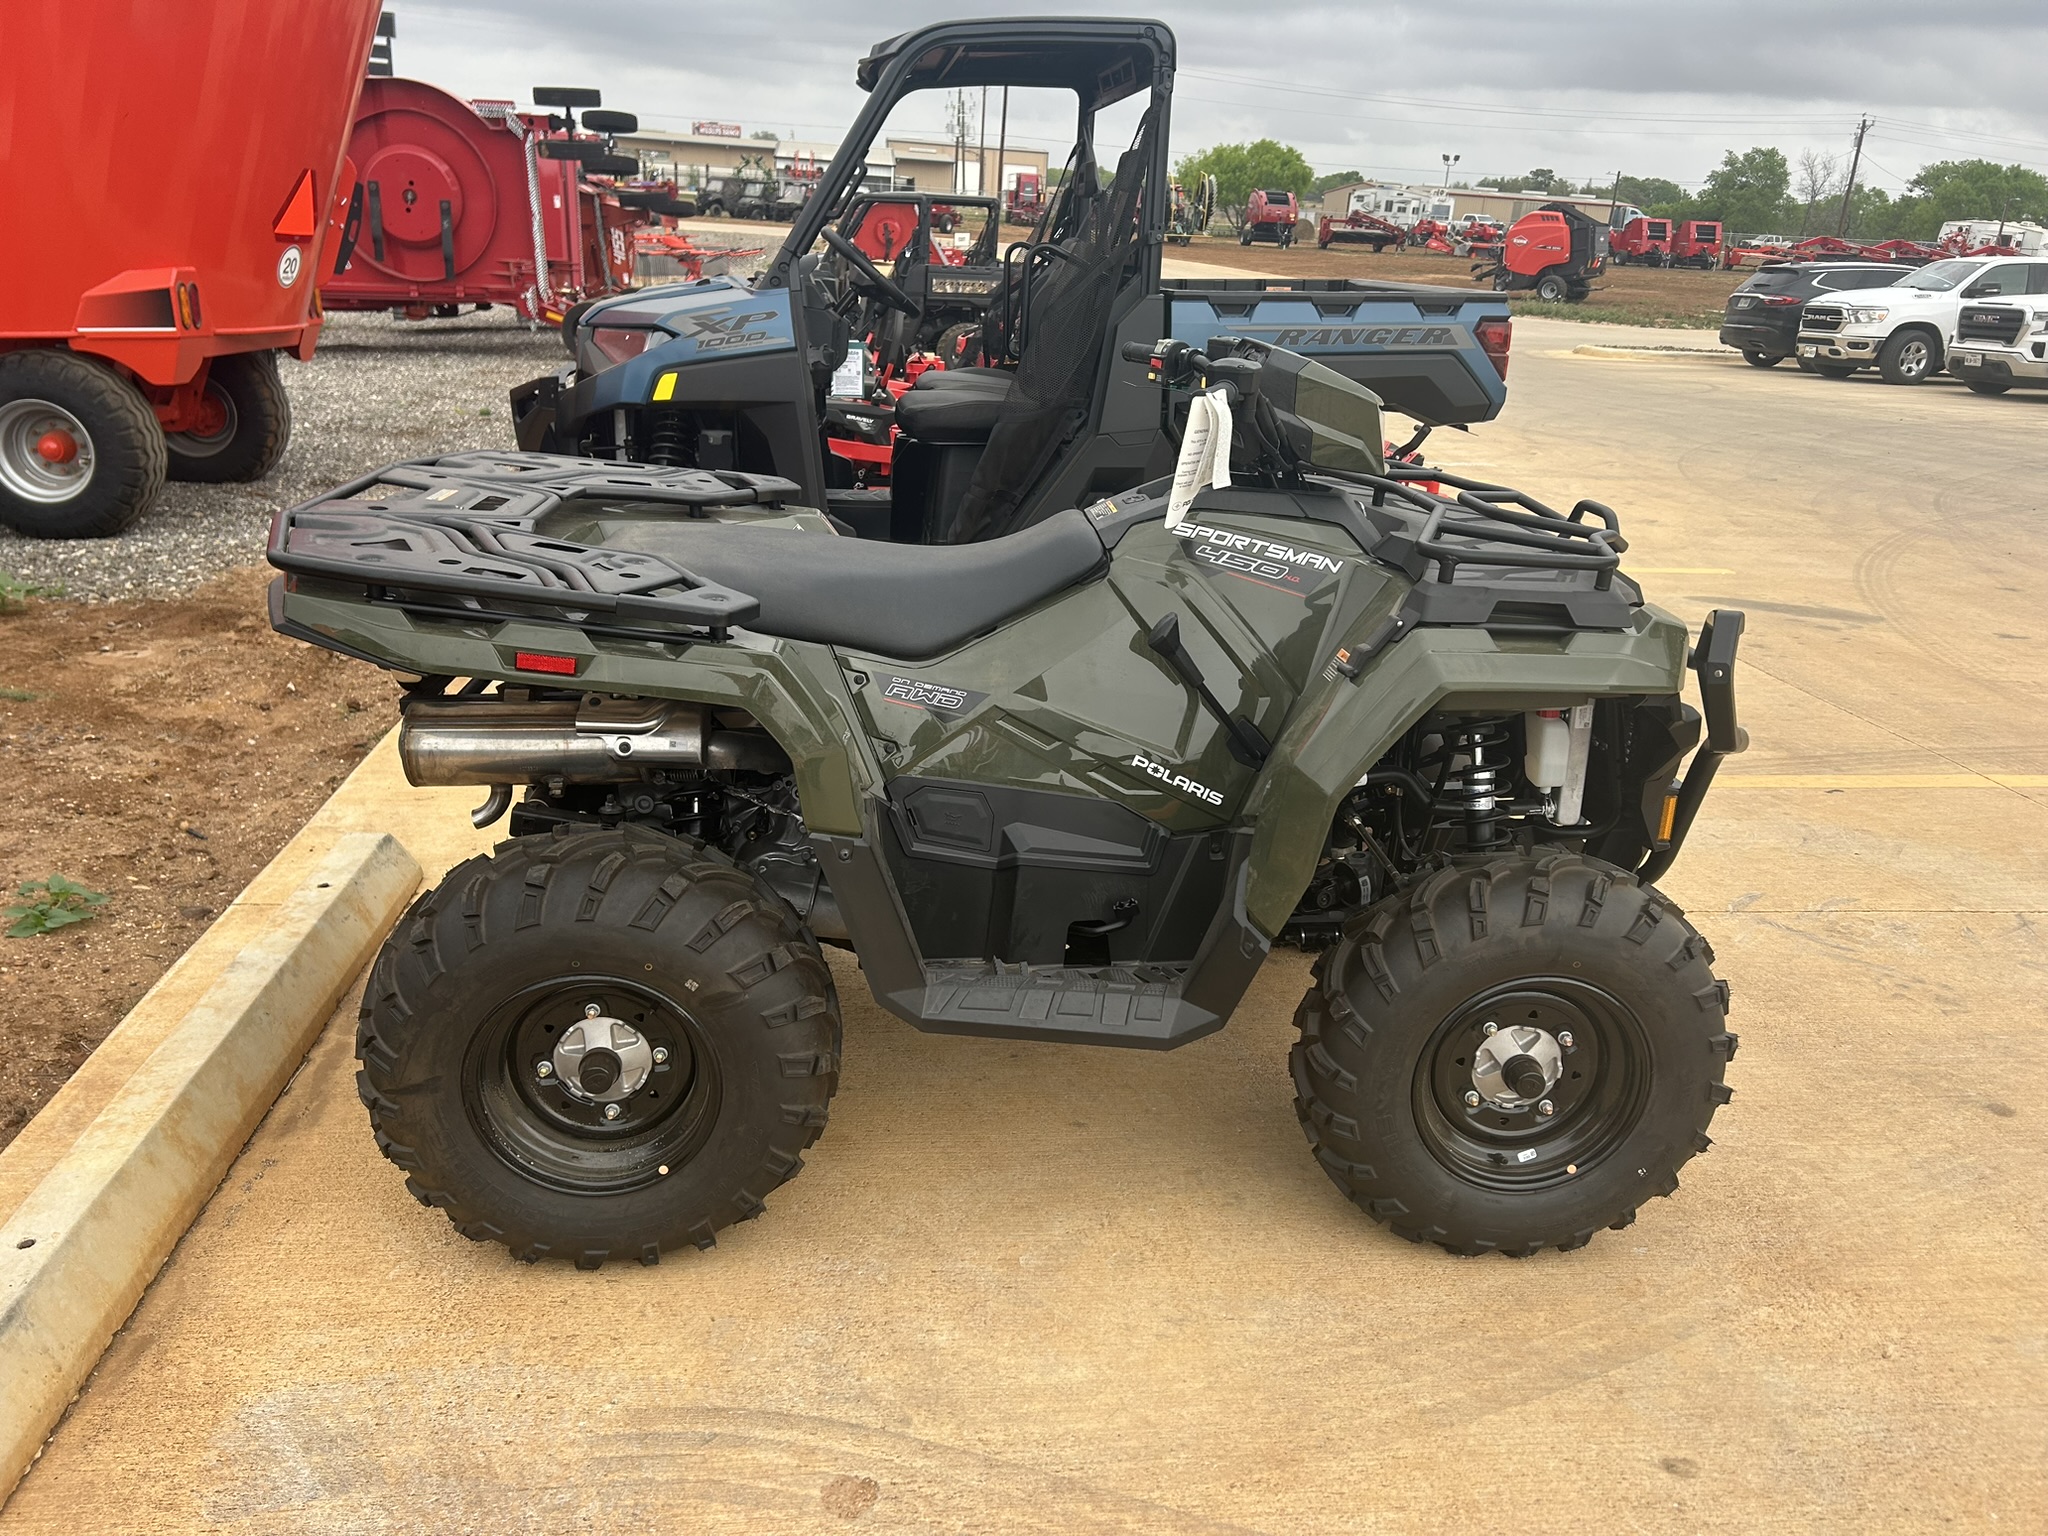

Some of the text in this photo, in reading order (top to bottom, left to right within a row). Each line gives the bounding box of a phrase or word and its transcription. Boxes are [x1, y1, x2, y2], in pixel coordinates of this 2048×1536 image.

[283, 257, 298, 274] 20
[682, 310, 780, 339] XP
[1973, 314, 1999, 323] GMC
[697, 331, 768, 349] 1000
[1273, 327, 1458, 346] RANGER
[846, 413, 874, 424] GRAVELY
[1172, 522, 1343, 574] SPORTSMAN
[1195, 545, 1288, 579] 450
[885, 683, 963, 709] AWD
[892, 677, 967, 697] ON DEMAND
[1131, 755, 1224, 806] POLARIS
